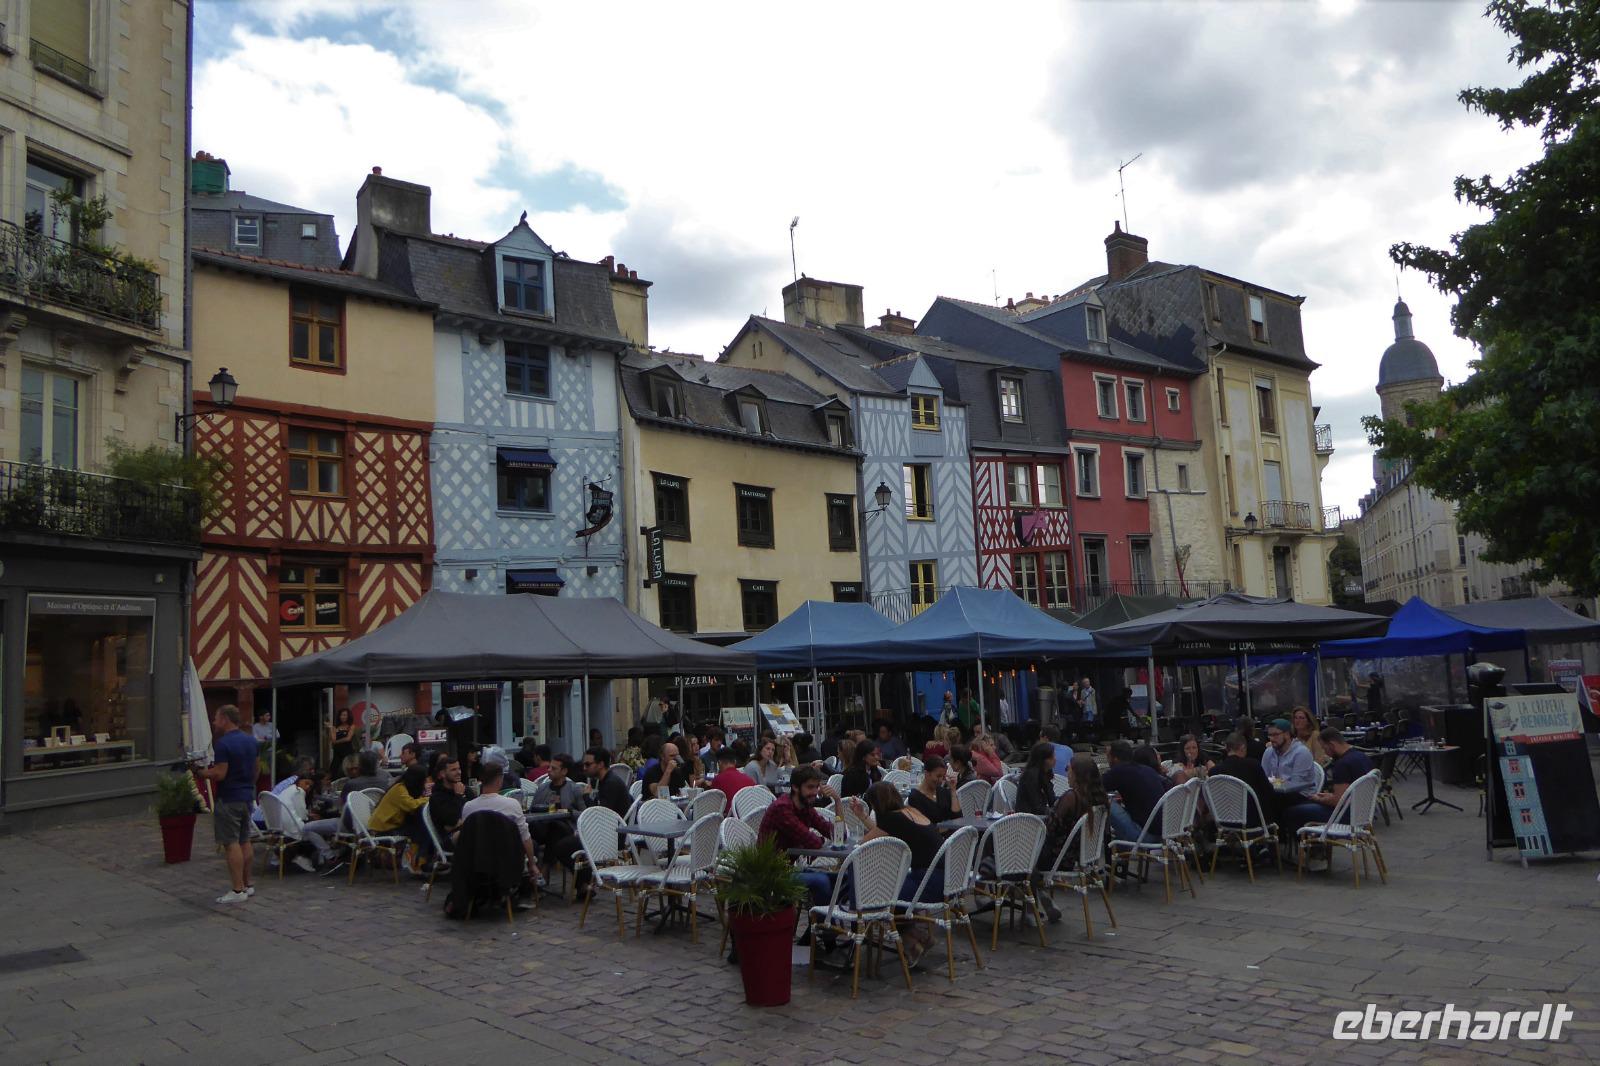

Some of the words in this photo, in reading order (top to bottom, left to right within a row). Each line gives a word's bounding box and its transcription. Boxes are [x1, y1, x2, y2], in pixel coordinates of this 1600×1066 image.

[674, 675, 718, 686] PIZZERIA
[1518, 701, 1529, 714] LA
[1520, 712, 1570, 728] RENNAISE
